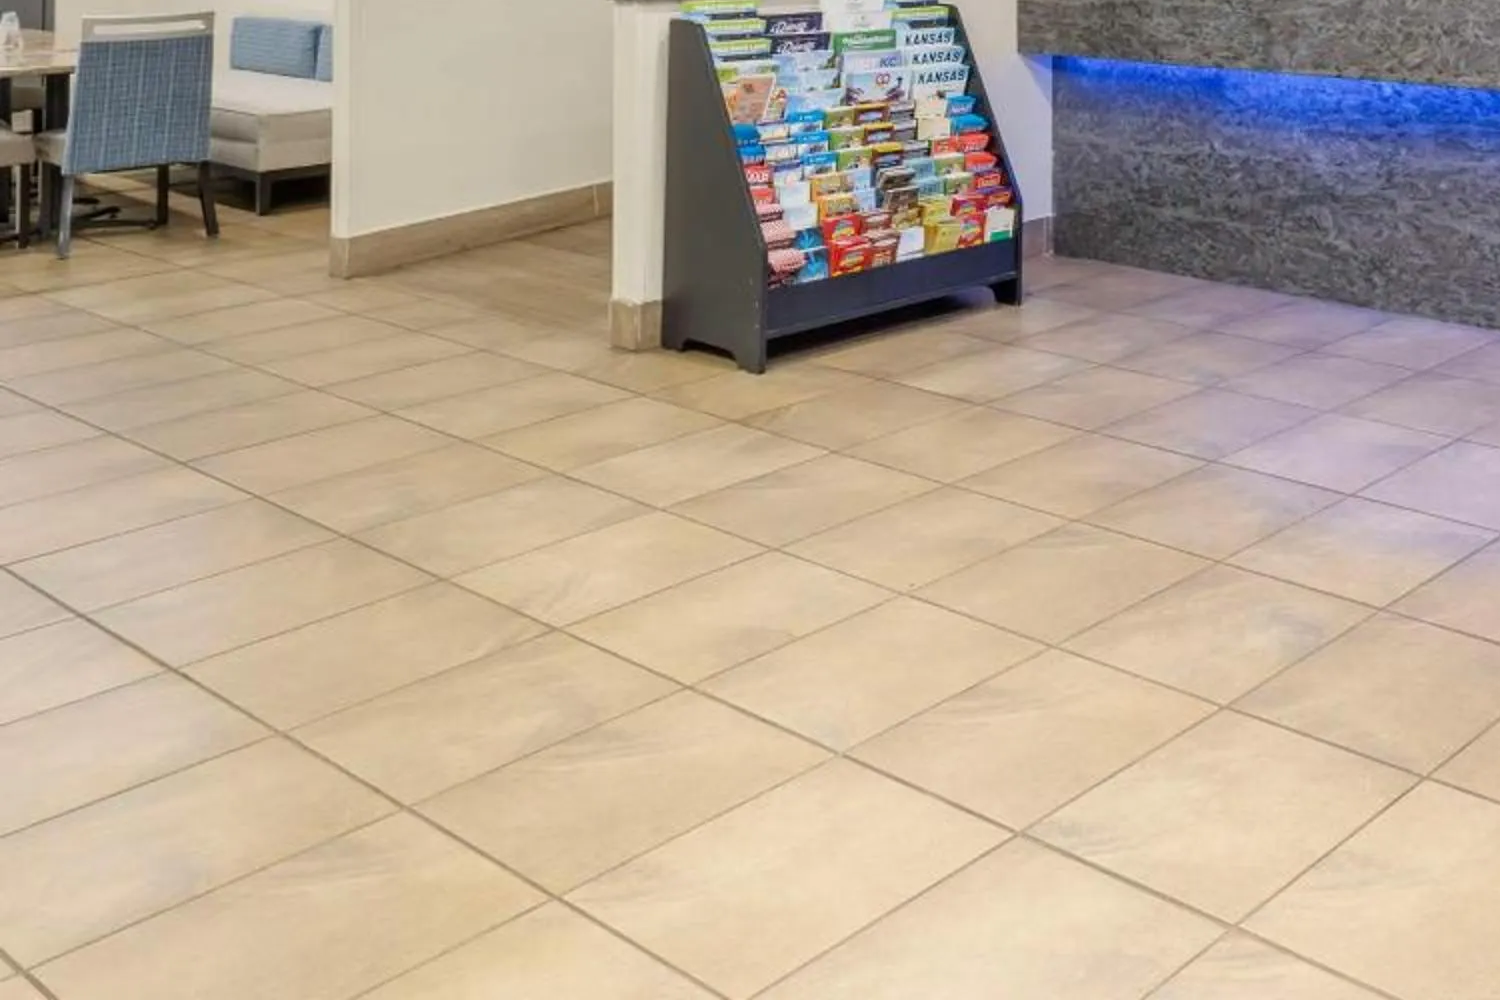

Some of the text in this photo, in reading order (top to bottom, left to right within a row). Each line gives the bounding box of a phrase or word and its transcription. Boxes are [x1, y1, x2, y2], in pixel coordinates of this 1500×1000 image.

[905, 31, 952, 45] KANSAS
[912, 50, 961, 65] KANSAS
[918, 71, 965, 84] KANSAS
